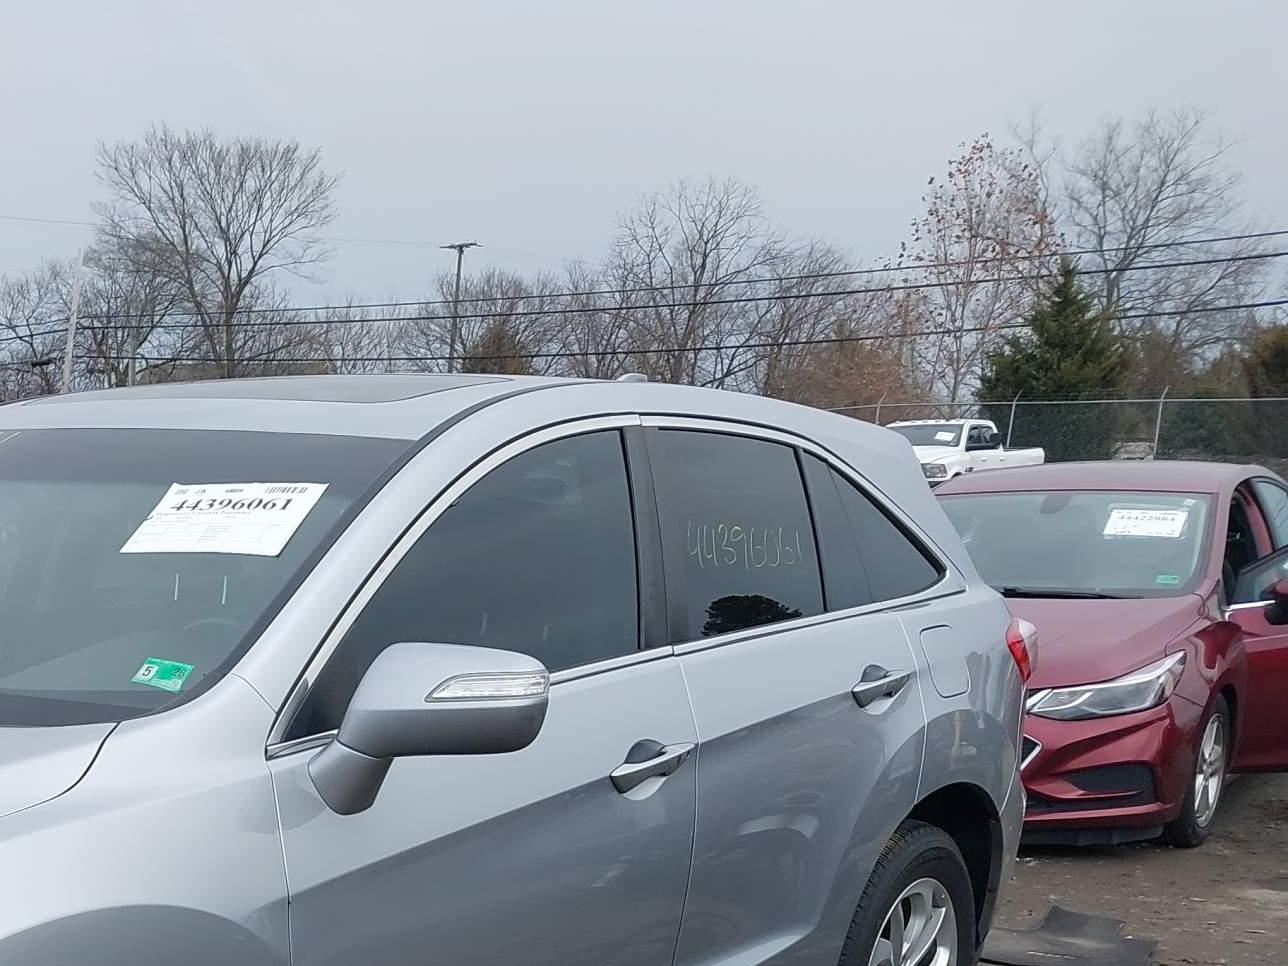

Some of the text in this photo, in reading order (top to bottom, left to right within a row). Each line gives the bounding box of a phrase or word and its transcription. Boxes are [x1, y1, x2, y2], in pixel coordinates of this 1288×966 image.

[170, 497, 294, 512] 44396061
[142, 665, 187, 678] 5 26
